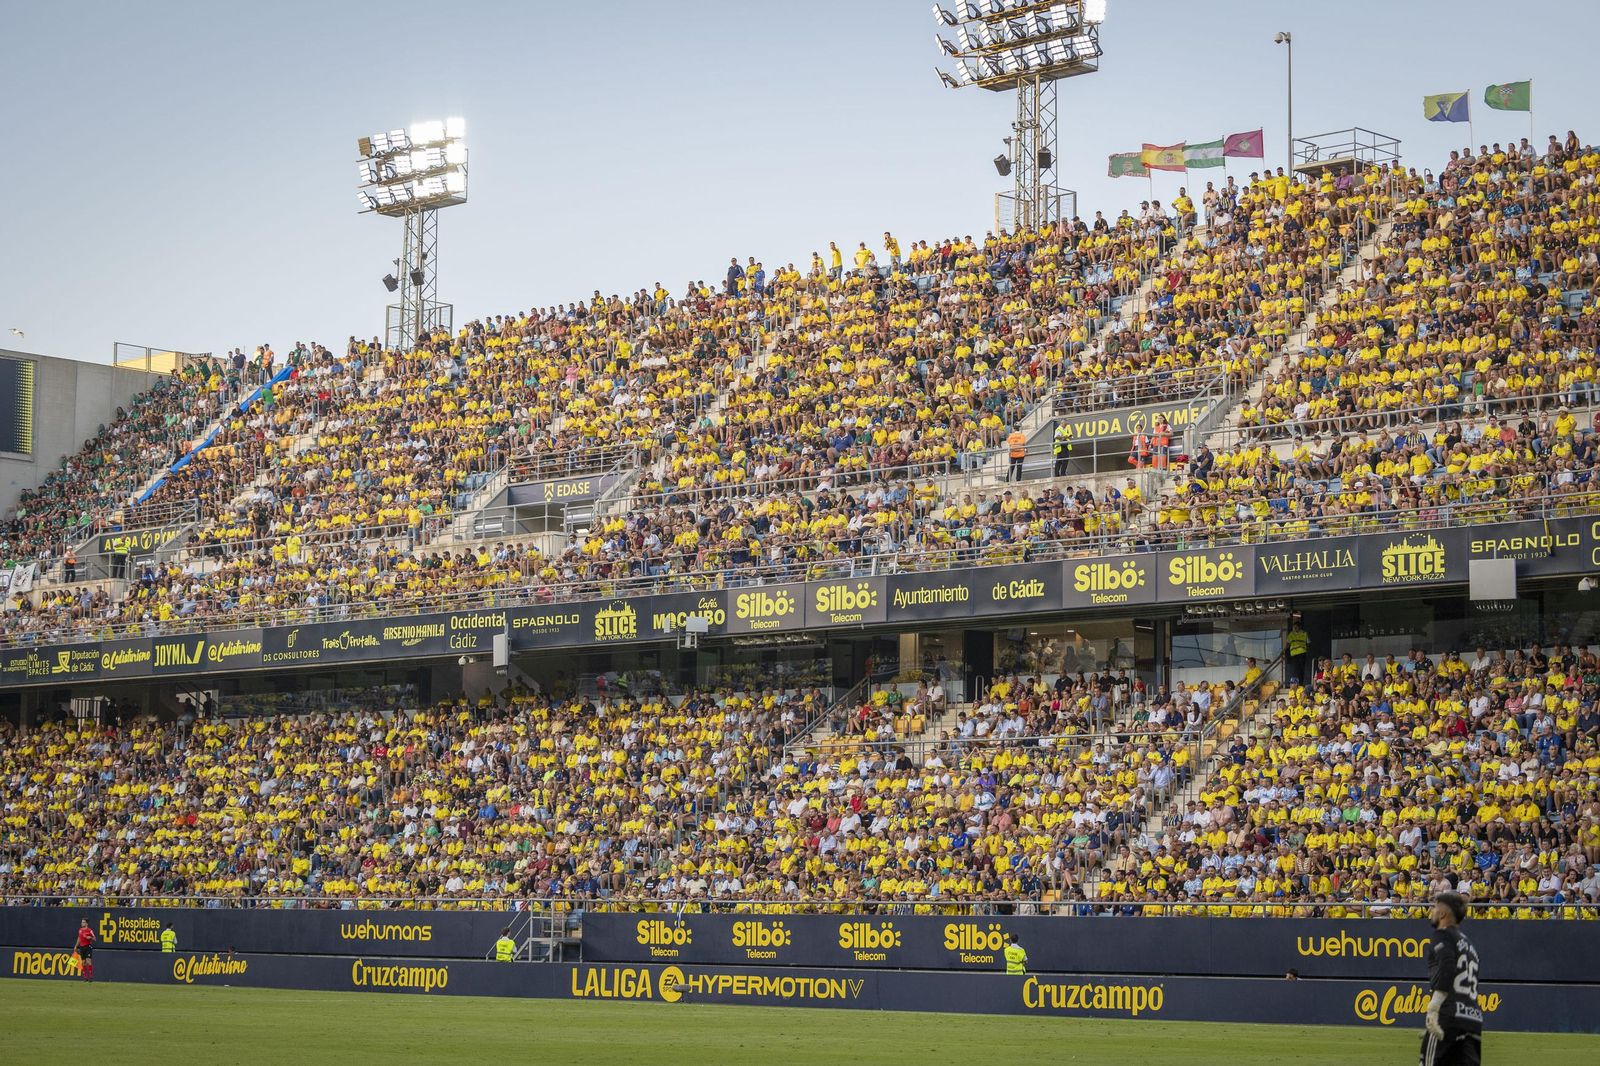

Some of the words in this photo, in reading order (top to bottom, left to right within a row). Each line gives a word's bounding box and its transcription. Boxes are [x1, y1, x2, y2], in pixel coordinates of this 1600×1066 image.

[557, 481, 591, 497] EDASE
[1471, 533, 1581, 553] SPAGNOLO
[1259, 549, 1356, 574] VALHALLA
[1530, 551, 1548, 559] 1933
[1168, 552, 1235, 586] Silbö
[1382, 551, 1446, 577] SLICE
[1074, 561, 1137, 592] Silbö
[1382, 576, 1399, 584] NEW
[1422, 573, 1445, 581] PIZZA
[893, 584, 970, 608] Ayuntamiento
[992, 584, 1007, 600] de
[1009, 579, 1045, 599] Cádiz
[1186, 585, 1225, 597] Telecom
[698, 597, 718, 610] Cafés
[736, 591, 787, 619] Silbö
[815, 583, 871, 613] Silbö
[1091, 593, 1128, 604] Telecom
[450, 611, 506, 630] Occidental
[512, 614, 580, 628] SPAGNOLO
[595, 615, 637, 636] SLICE
[749, 618, 780, 630] Telecom
[830, 612, 862, 623] Telecom
[450, 632, 477, 649] Cádiz
[29, 653, 38, 662] NO
[71, 649, 100, 661] Diputación
[263, 653, 273, 662] DS
[273, 650, 320, 661] CONSULTORES
[29, 660, 50, 669] LIMITS
[29, 668, 50, 676] SPACES
[71, 664, 79, 672] de
[79, 662, 95, 672] Cádiz
[118, 916, 161, 930] Hospitales
[341, 919, 433, 942] wehumans
[118, 929, 160, 944] PASCUAL
[636, 919, 685, 946] Silbö
[731, 921, 785, 947] Silbö
[838, 922, 894, 949] Silbö
[943, 923, 1003, 951] Silbö
[650, 946, 679, 957] Telecom
[745, 949, 777, 960] Telecom
[853, 951, 886, 961] Telecom
[959, 953, 994, 964] Telecom
[352, 958, 449, 993] Cruzcampo
[571, 967, 653, 998] LALIGA
[688, 974, 847, 1000] HYPERMOTION
[1022, 975, 1164, 1016] Cruzcampo
